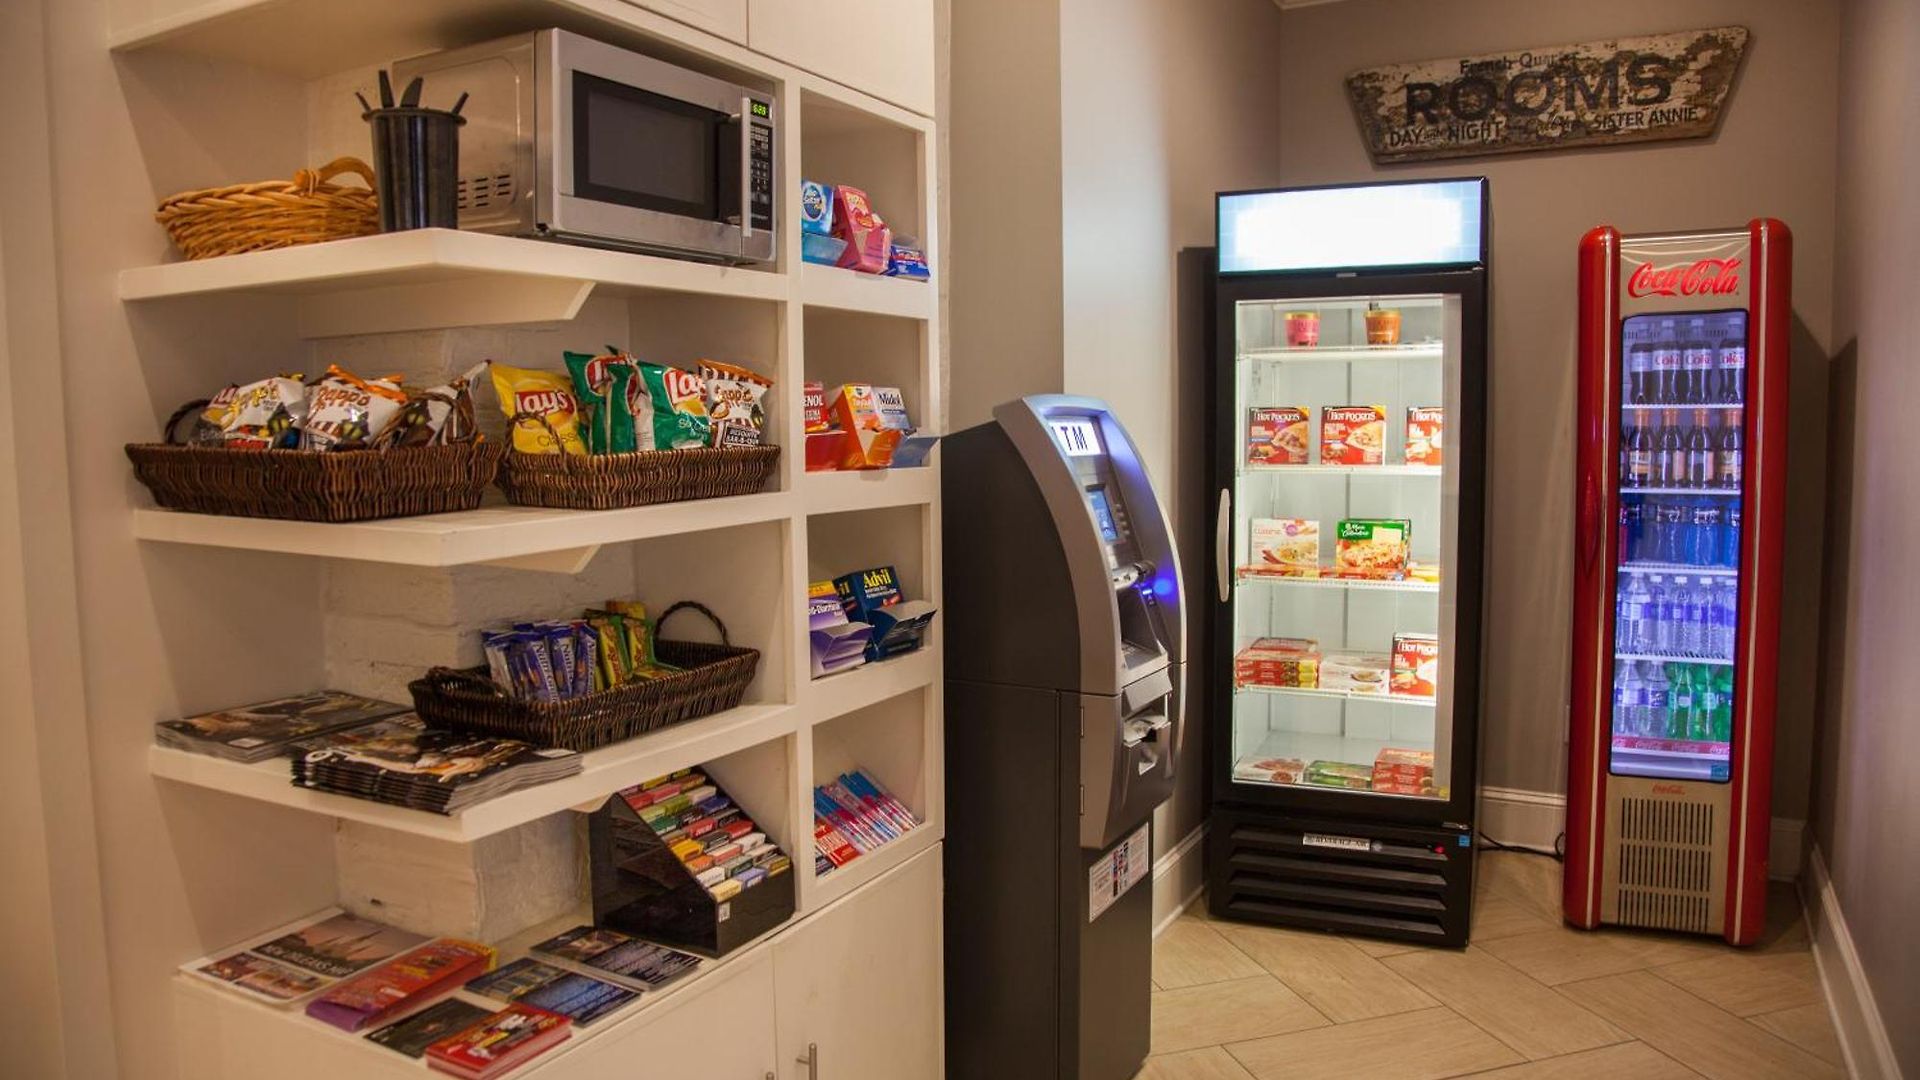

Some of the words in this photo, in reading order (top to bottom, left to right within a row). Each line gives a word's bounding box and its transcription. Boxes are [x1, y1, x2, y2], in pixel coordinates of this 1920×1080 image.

[1405, 51, 1672, 126] ROOMS
[1594, 111, 1644, 129] SISTER
[1650, 107, 1699, 124] ANNIE
[1389, 127, 1423, 147] DAY
[1447, 120, 1504, 143] NIGHT
[803, 394, 825, 408] ENOL
[1052, 425, 1088, 451] TM
[864, 567, 893, 589] Advil
